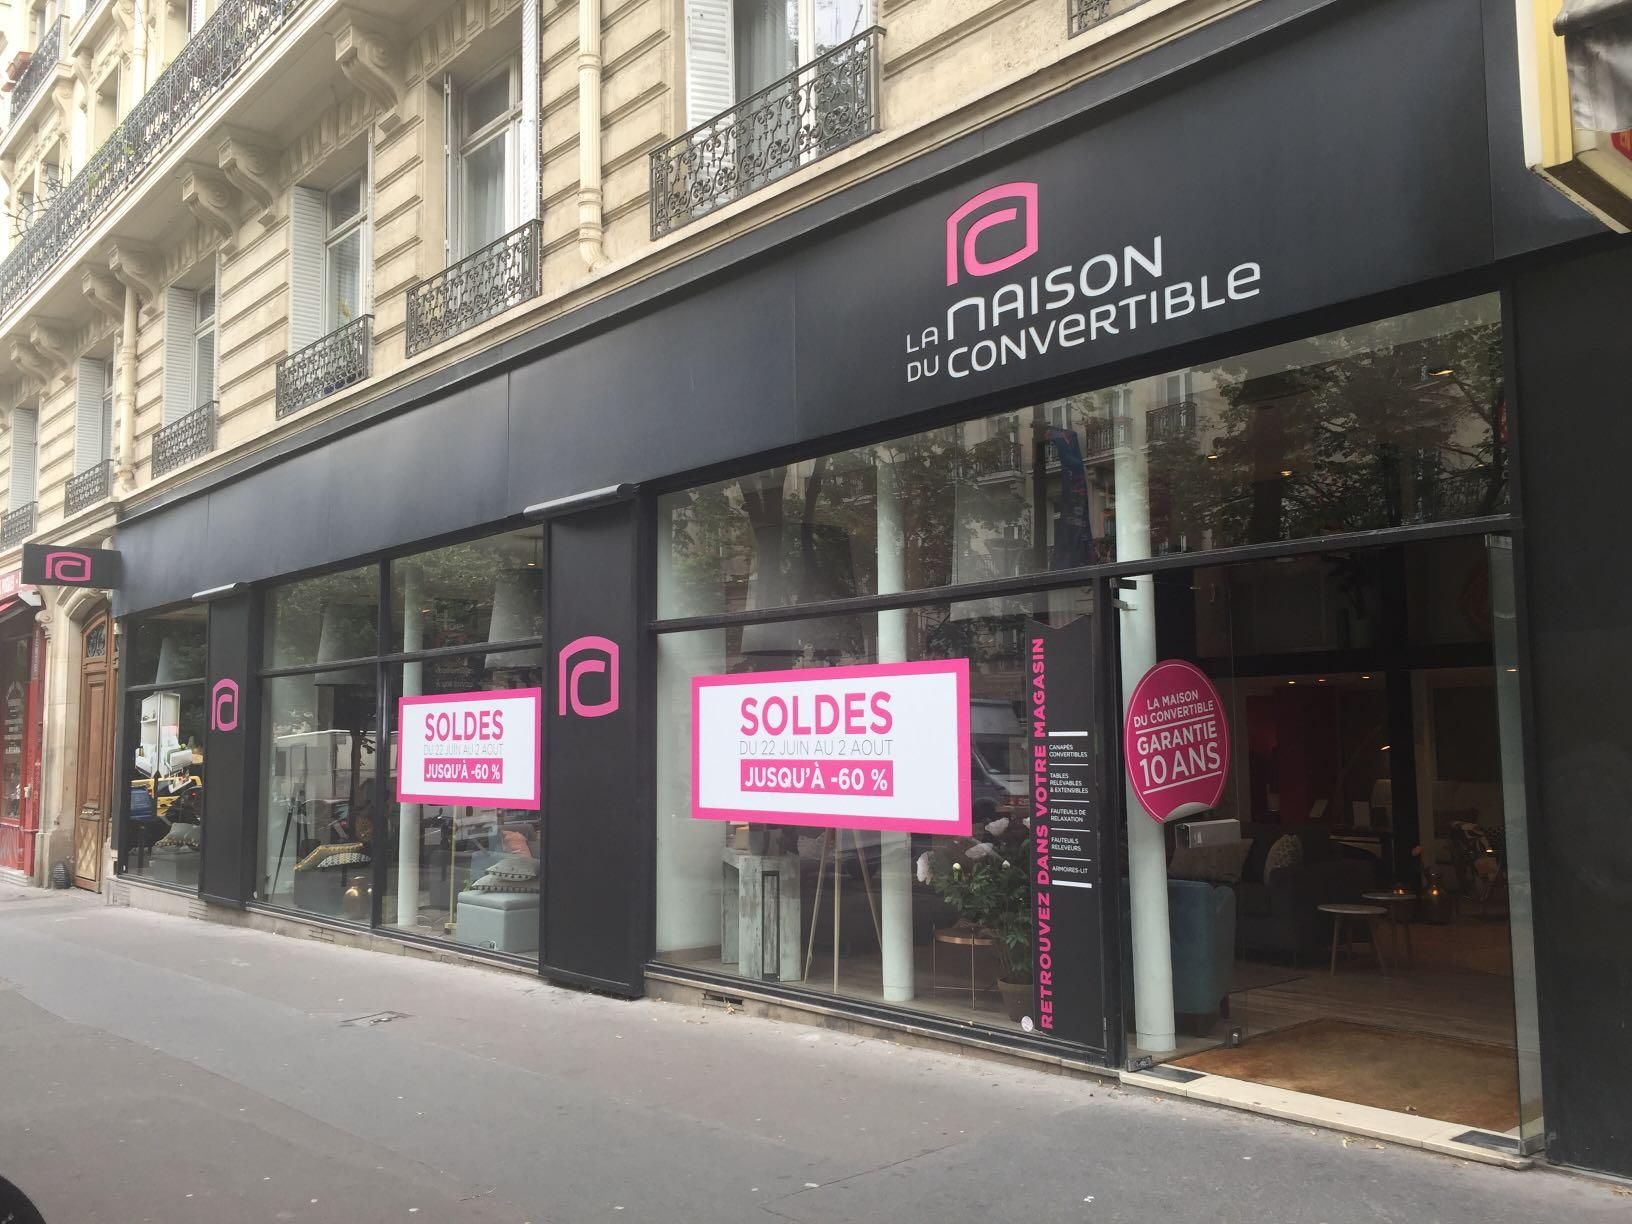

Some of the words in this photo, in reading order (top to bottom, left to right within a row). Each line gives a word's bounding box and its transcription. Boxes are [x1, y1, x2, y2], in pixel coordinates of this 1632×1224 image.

[906, 326, 939, 354] LA
[946, 235, 1163, 341] MAISON
[907, 355, 940, 383] DU
[1032, 638, 1046, 738] MAGASIN
[1146, 697, 1160, 711] LA
[1162, 689, 1199, 706] MAISON
[424, 709, 504, 742] SOLDES
[740, 691, 893, 736] SOLDES
[1133, 713, 1148, 728] DU
[1149, 700, 1214, 725] CONVERTIBLE
[423, 745, 434, 756] DU
[435, 744, 444, 756] 22
[445, 744, 462, 756] JUIN
[463, 744, 474, 755] AU
[475, 743, 481, 755] 2
[482, 743, 504, 756] AOUT
[739, 740, 757, 756] DU
[761, 740, 775, 756] 22
[779, 740, 809, 756] JUIN
[813, 740, 834, 756] AU
[838, 739, 847, 756] 2
[851, 739, 894, 756] AOUT
[1136, 720, 1218, 756] GARANTIE
[425, 759, 469, 779] JUSQU'À
[470, 763, 489, 780] -60
[491, 763, 501, 780] %
[744, 761, 825, 789] JUSQU'À
[830, 767, 865, 791] -60
[870, 768, 888, 791] %
[1139, 754, 1167, 787] 10
[1171, 741, 1221, 781] ANS
[1034, 745, 1049, 817] VOTRE
[1050, 815, 1084, 823] RELAXATION
[1036, 824, 1050, 885] DANS
[1051, 836, 1079, 844] FAUTEUILS
[1051, 844, 1082, 852] RELEVEURS
[1038, 892, 1054, 1030] RETROUVEZ
